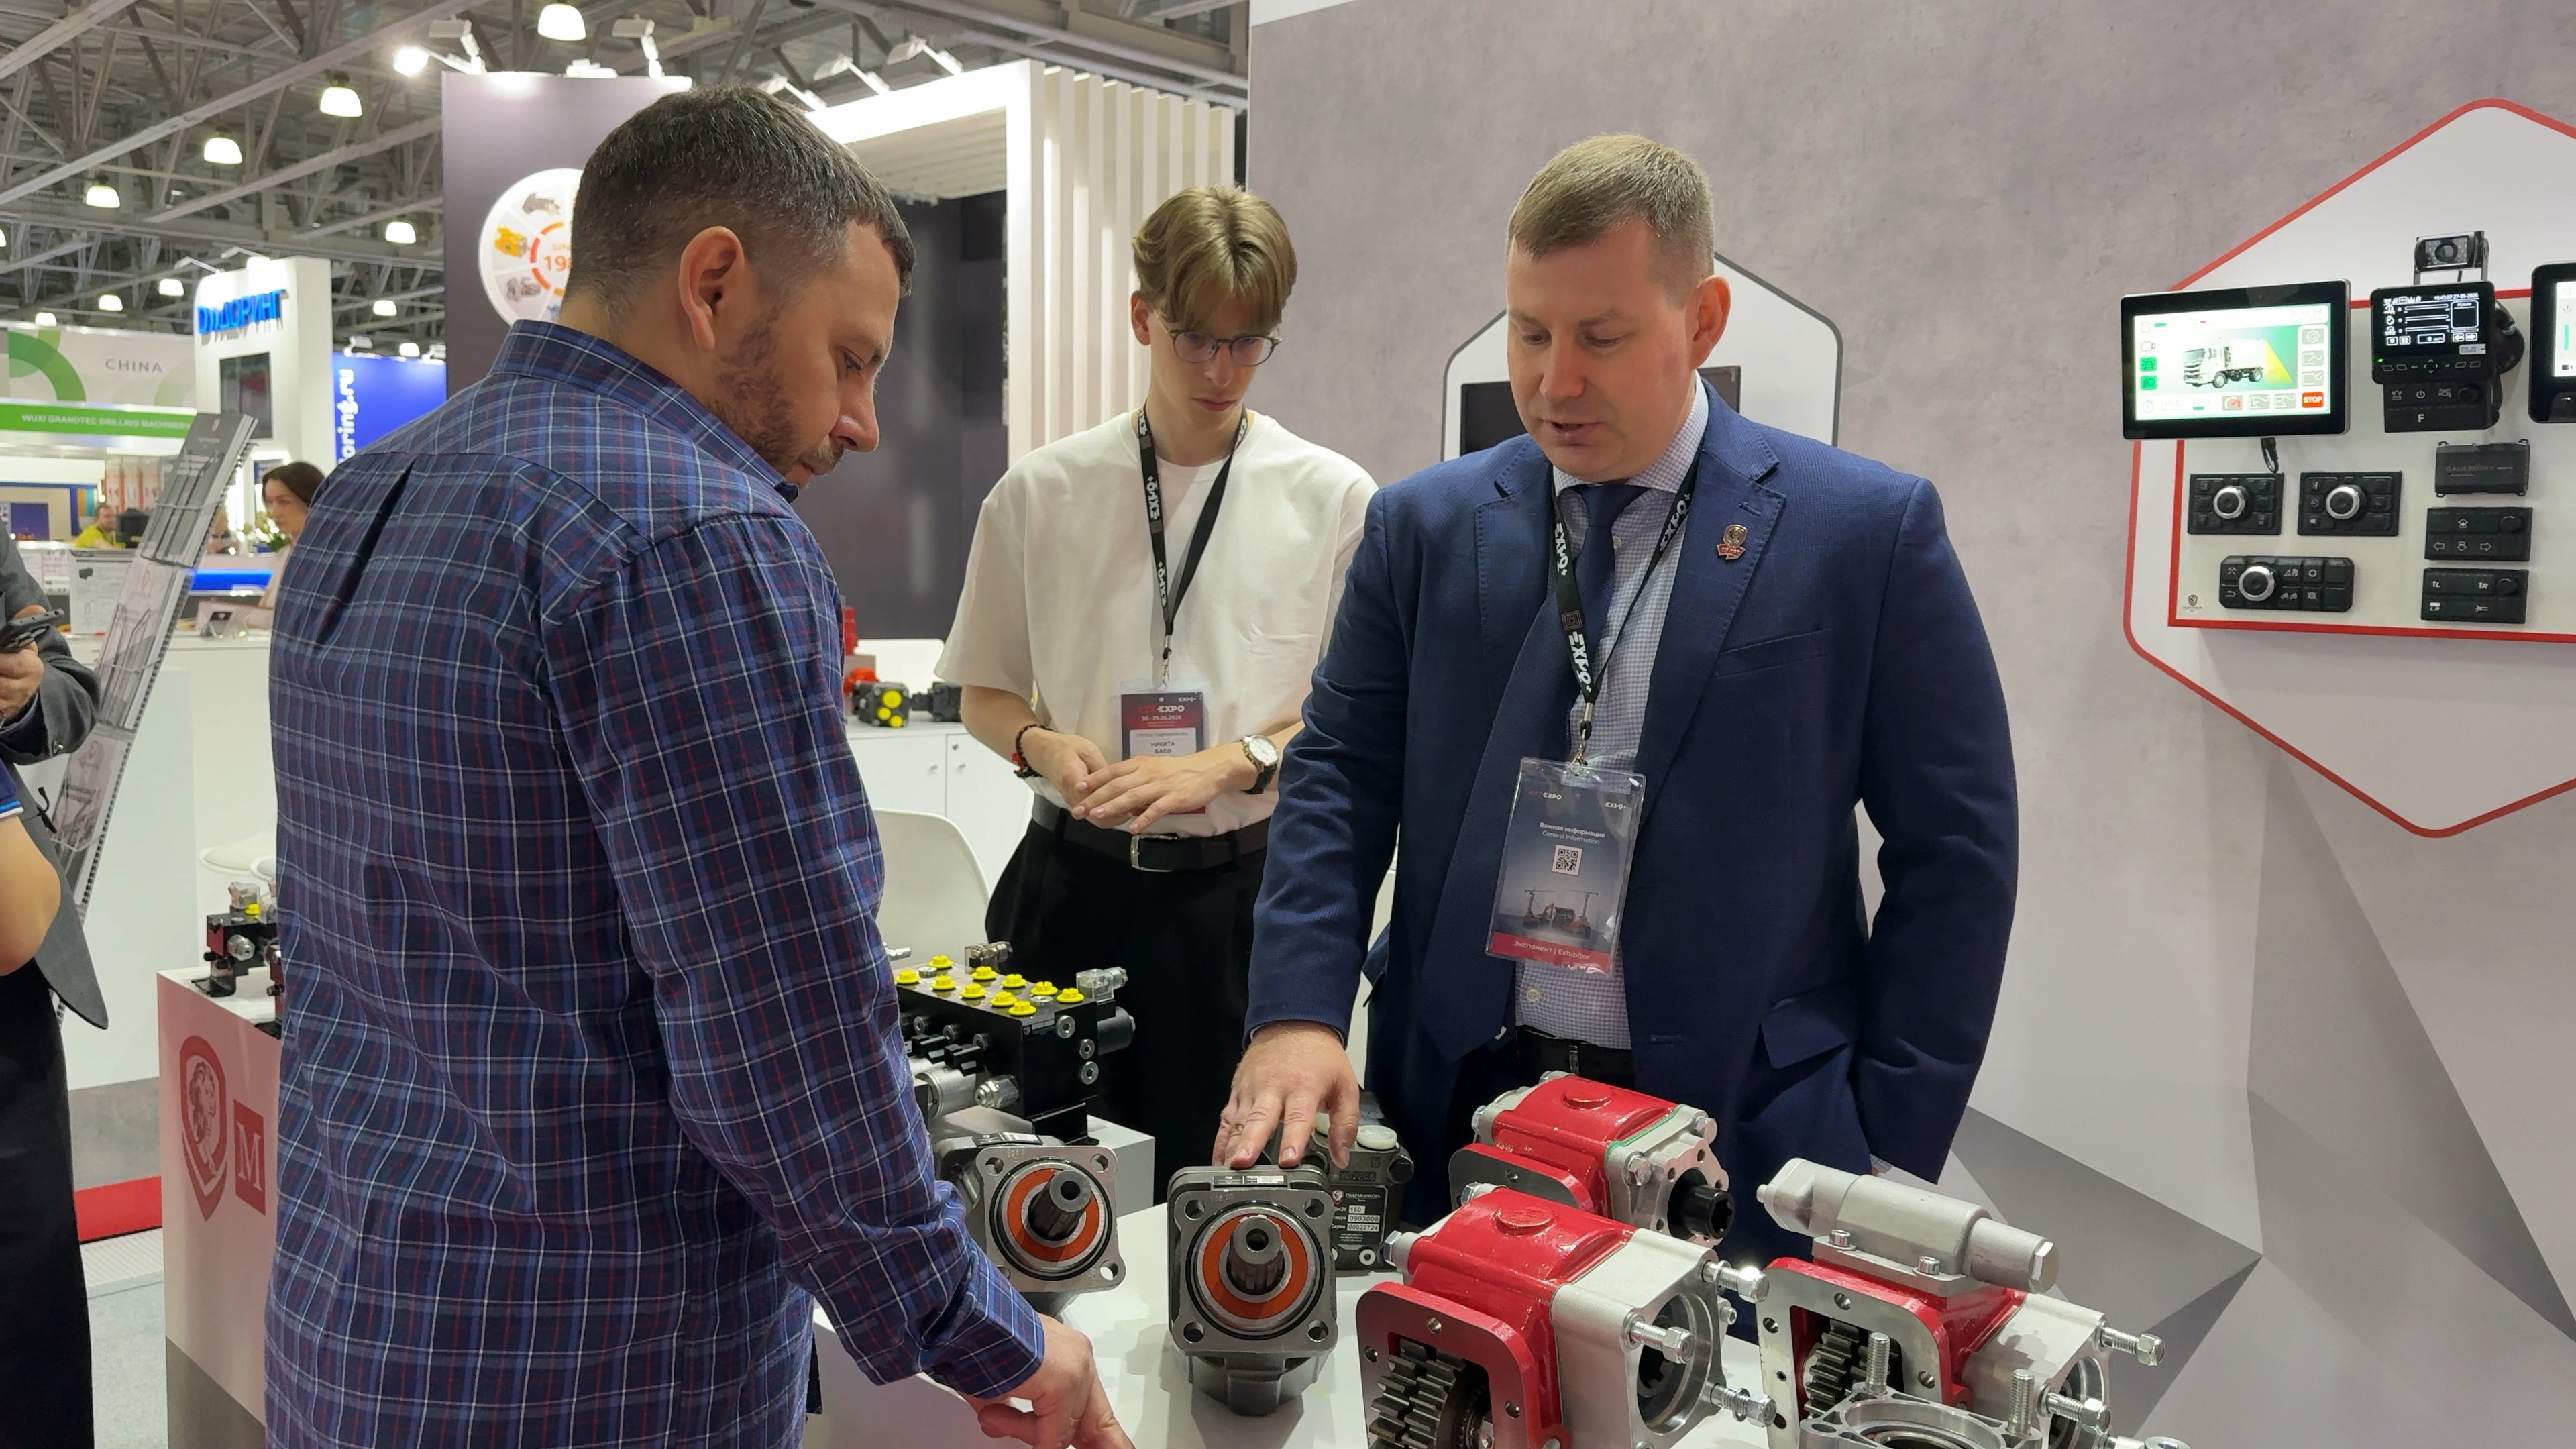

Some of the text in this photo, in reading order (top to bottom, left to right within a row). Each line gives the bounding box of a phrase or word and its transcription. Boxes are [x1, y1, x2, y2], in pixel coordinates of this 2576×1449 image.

[105, 358, 163, 374] CHINA
[2303, 396, 2322, 404] STOP
[21, 414, 46, 423] WUXI
[48, 415, 97, 426] GRANDTEC
[99, 417, 140, 427] DRILLING
[337, 369, 358, 464] oring.ru
[2418, 414, 2424, 423] F
[1543, 792, 1562, 800] EXPO
[1540, 822, 1605, 838] Важная информация
[1542, 830, 1600, 845] General Information
[1513, 940, 1552, 953] Экспонент
[1558, 949, 1590, 960] Exhibitor
